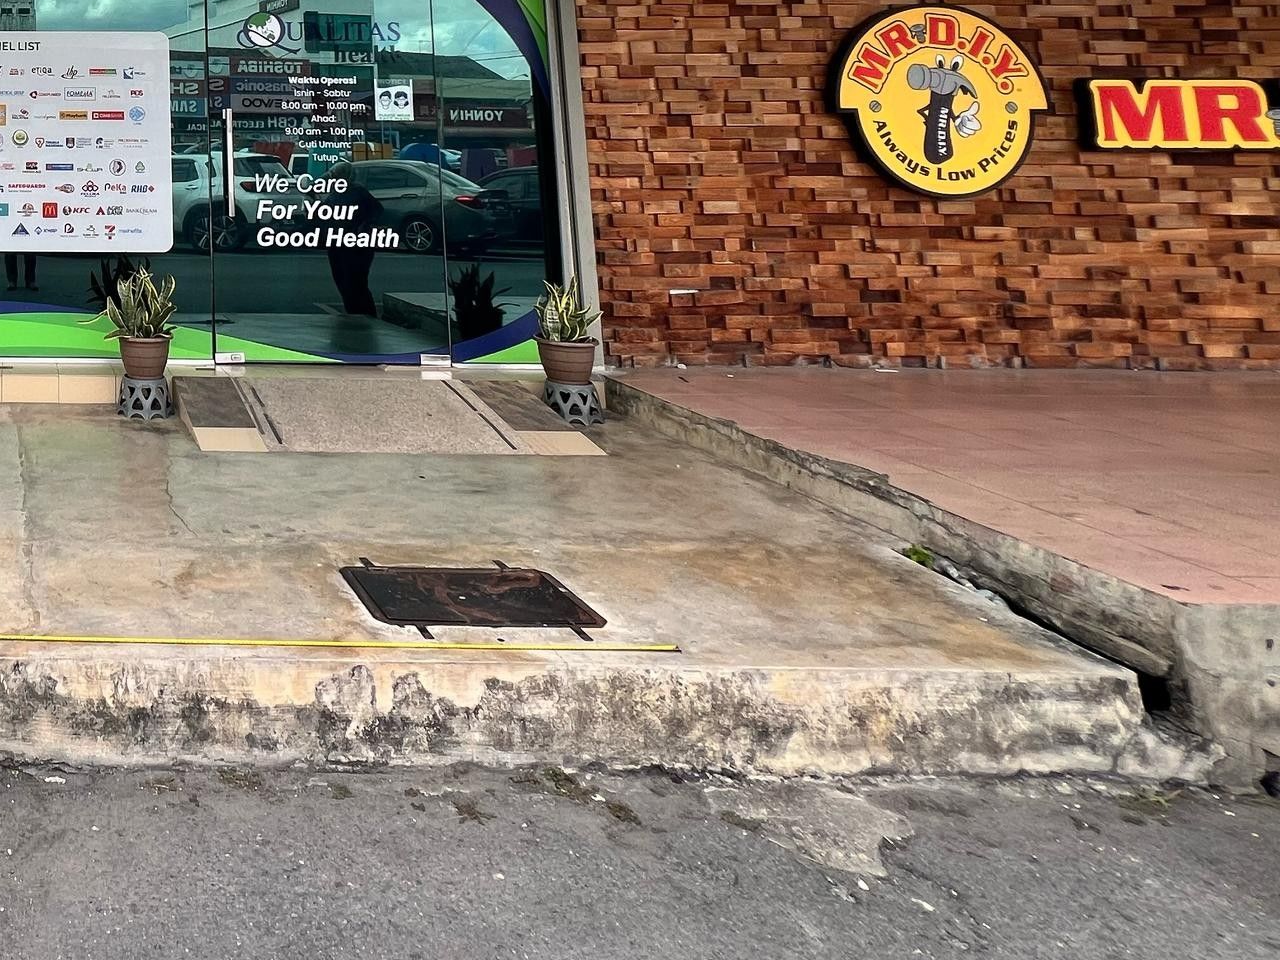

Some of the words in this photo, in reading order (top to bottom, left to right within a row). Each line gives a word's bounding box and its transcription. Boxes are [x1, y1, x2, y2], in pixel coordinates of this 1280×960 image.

[236, 12, 400, 54] QUALITAS
[18, 41, 40, 51] LIST
[321, 76, 356, 86] Operasi
[350, 103, 365, 112] pm
[1098, 85, 1267, 142] MR
[348, 129, 364, 137] pm
[299, 140, 317, 148] Cuti
[872, 119, 930, 178] Always
[936, 166, 976, 182] Low
[978, 120, 1018, 172] Prices
[313, 154, 338, 163] Tutup
[254, 173, 290, 193] We
[296, 173, 348, 193] Care
[256, 200, 298, 220] For
[304, 200, 358, 220] Your
[256, 227, 320, 248] Good
[325, 227, 400, 248] Health
